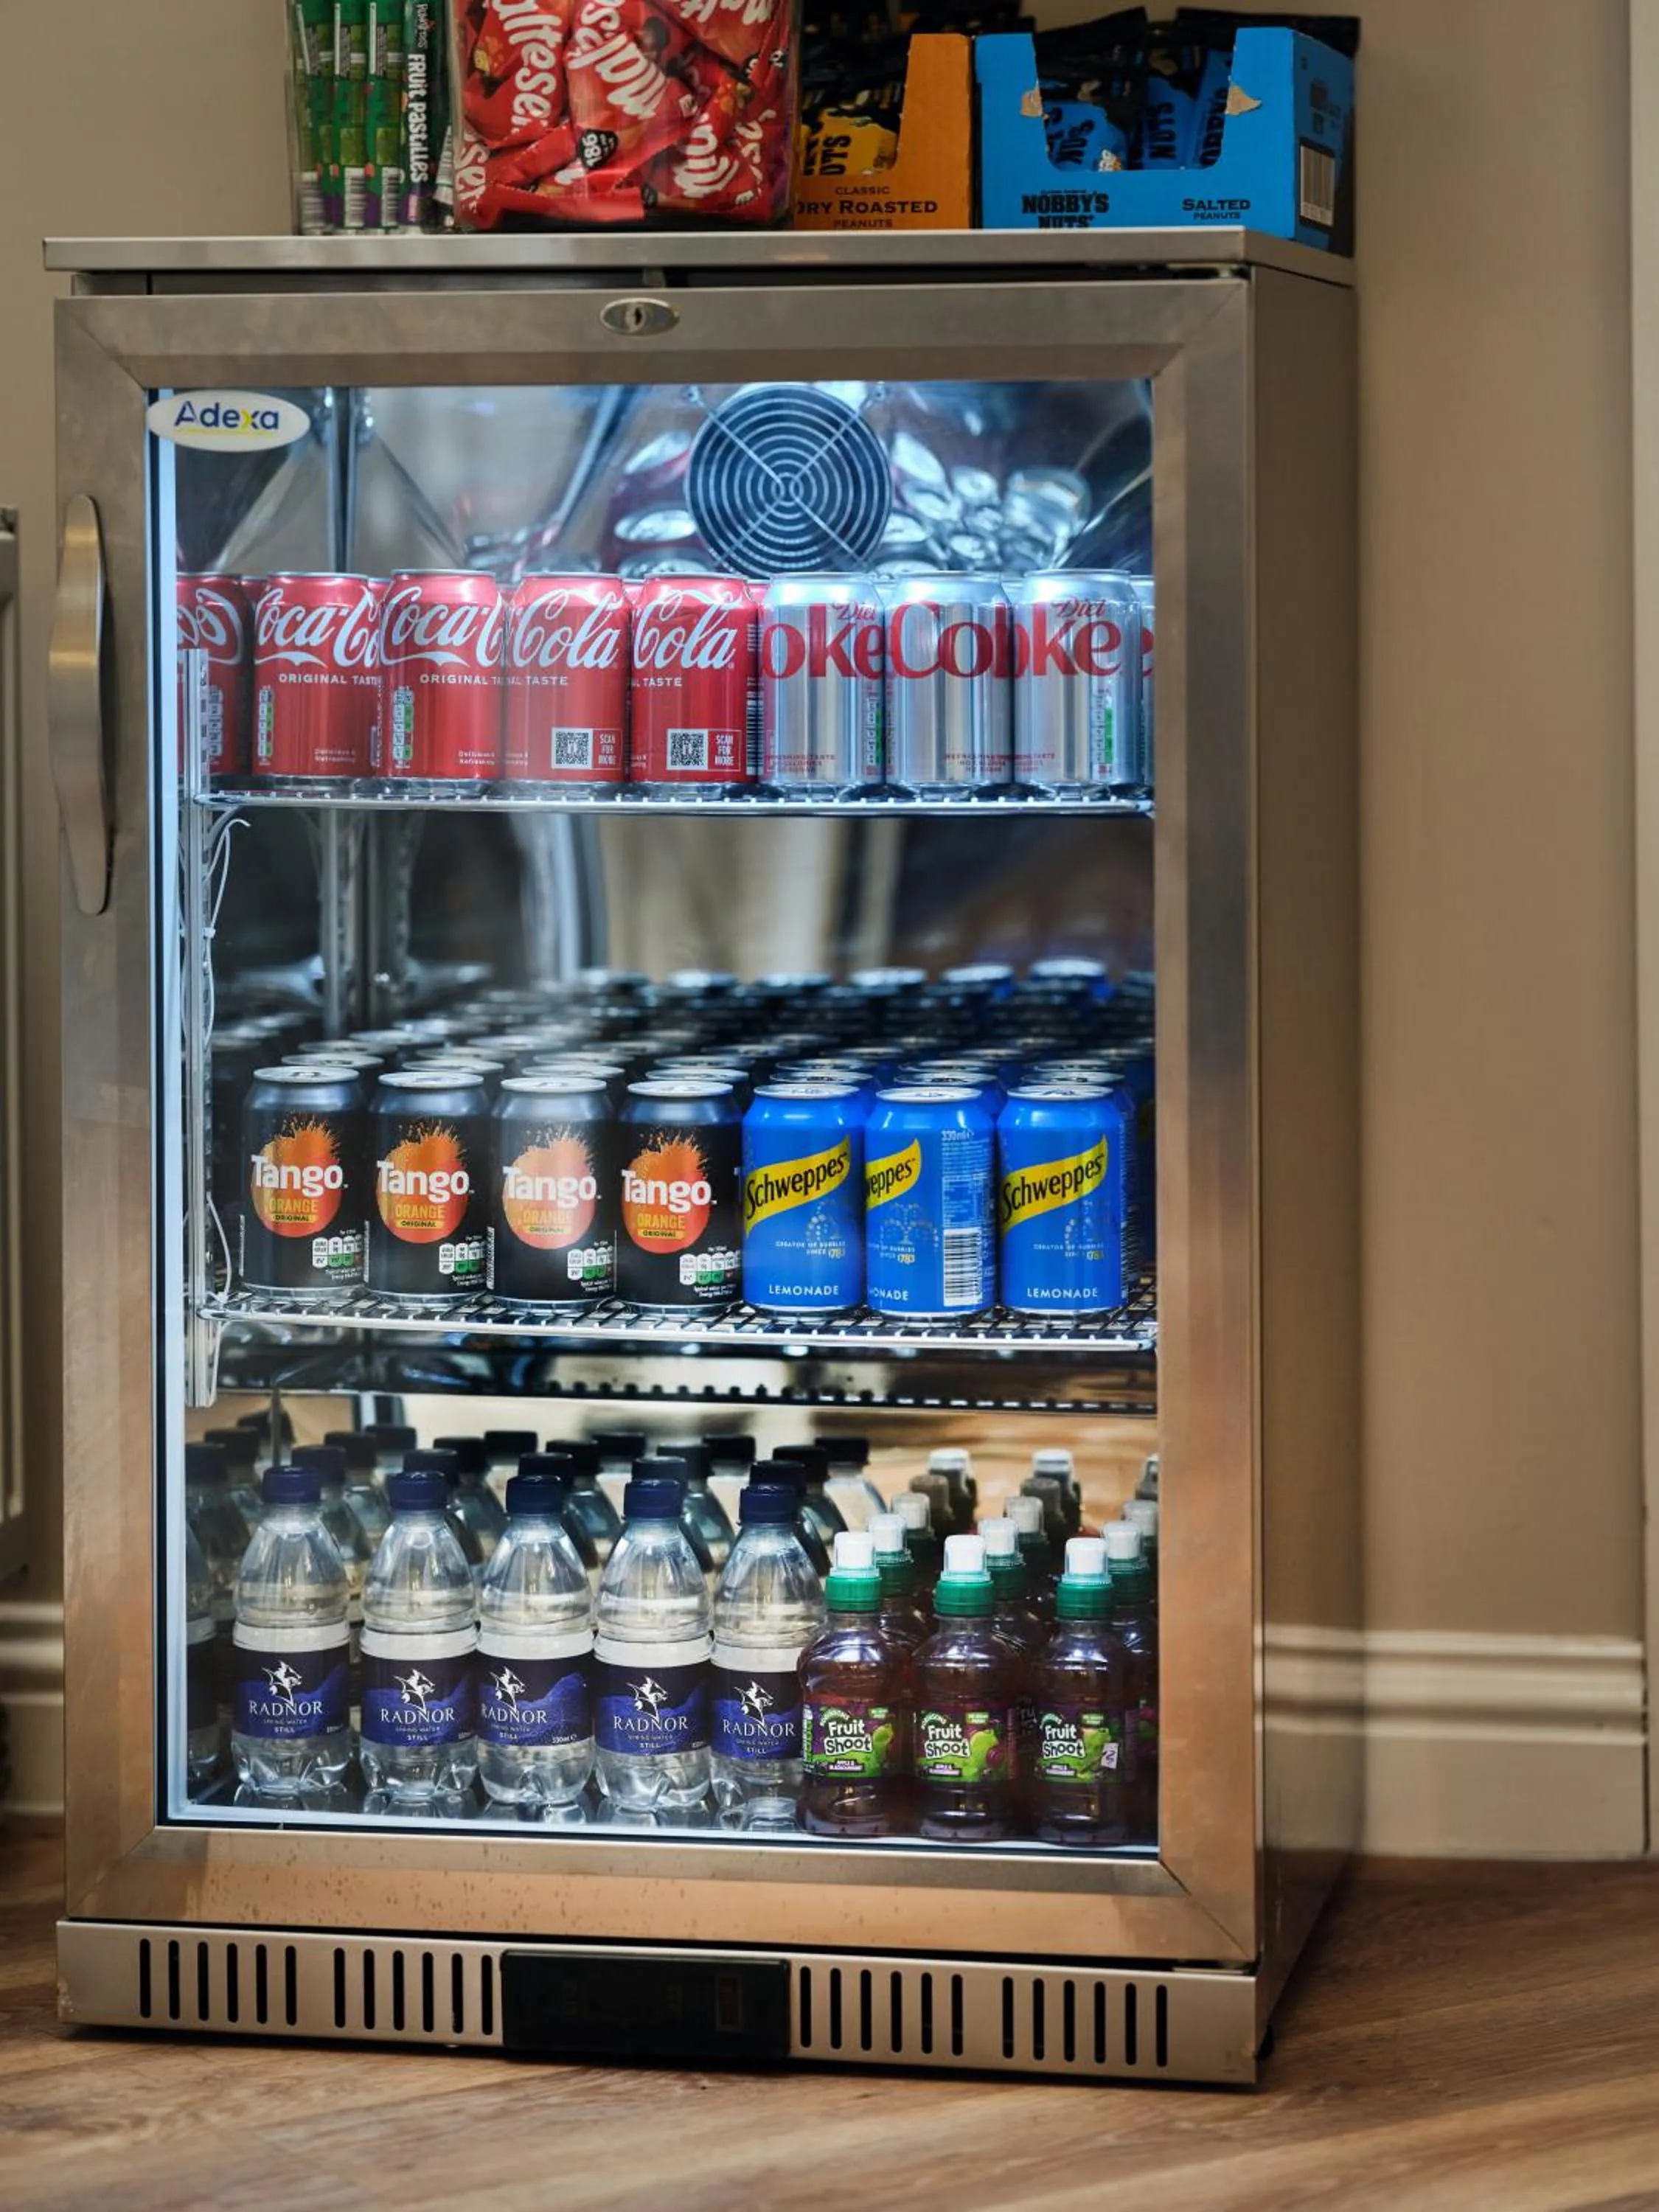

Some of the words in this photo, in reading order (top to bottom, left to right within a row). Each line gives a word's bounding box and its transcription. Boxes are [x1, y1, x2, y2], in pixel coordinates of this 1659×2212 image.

[835, 187, 891, 195] CLASSIC
[839, 200, 938, 214] ROASTED
[1021, 192, 1110, 214] NOBBY'S
[1182, 199, 1251, 211] SALTED
[833, 219, 893, 228] PEANUTS
[1193, 212, 1241, 220] PEANUTS
[174, 400, 279, 431] Adexa
[832, 601, 877, 621] Diet
[1052, 596, 1107, 619] Diet
[762, 603, 884, 680] oke
[279, 672, 347, 684] ORIGINAL
[420, 672, 488, 685] ORIGINAL
[526, 676, 569, 686] TASTE
[643, 677, 683, 687] TASTE
[251, 1154, 343, 1197] Tango
[377, 1160, 470, 1203] Tango
[869, 1160, 914, 1198] eppes
[502, 1166, 597, 1209] Tango
[621, 1169, 712, 1214] Tango
[746, 1155, 845, 1220] Schweppes
[1002, 1157, 1102, 1224] Schweppes
[268, 1198, 319, 1212] ORANGE
[394, 1203, 445, 1219] ORANGE
[522, 1209, 574, 1224] ORANGE
[636, 1214, 686, 1229] ORANGE
[768, 1284, 839, 1296] LEMONADE
[871, 1287, 909, 1301] ONADE
[1026, 1287, 1098, 1298] LEMONADE
[248, 1699, 323, 1716] RADNOR
[380, 1707, 455, 1724] RADNOR
[481, 1703, 548, 1724] RADNOR
[613, 1715, 689, 1732] RADNOR
[723, 1719, 796, 1737] RADNOR
[828, 1719, 865, 1736] Fruit
[928, 1723, 962, 1740] Fruit
[1045, 1723, 1077, 1740] Fruit
[826, 1737, 871, 1753] Shoot
[926, 1742, 968, 1757] Shoot
[1043, 1742, 1083, 1757] Shoot
